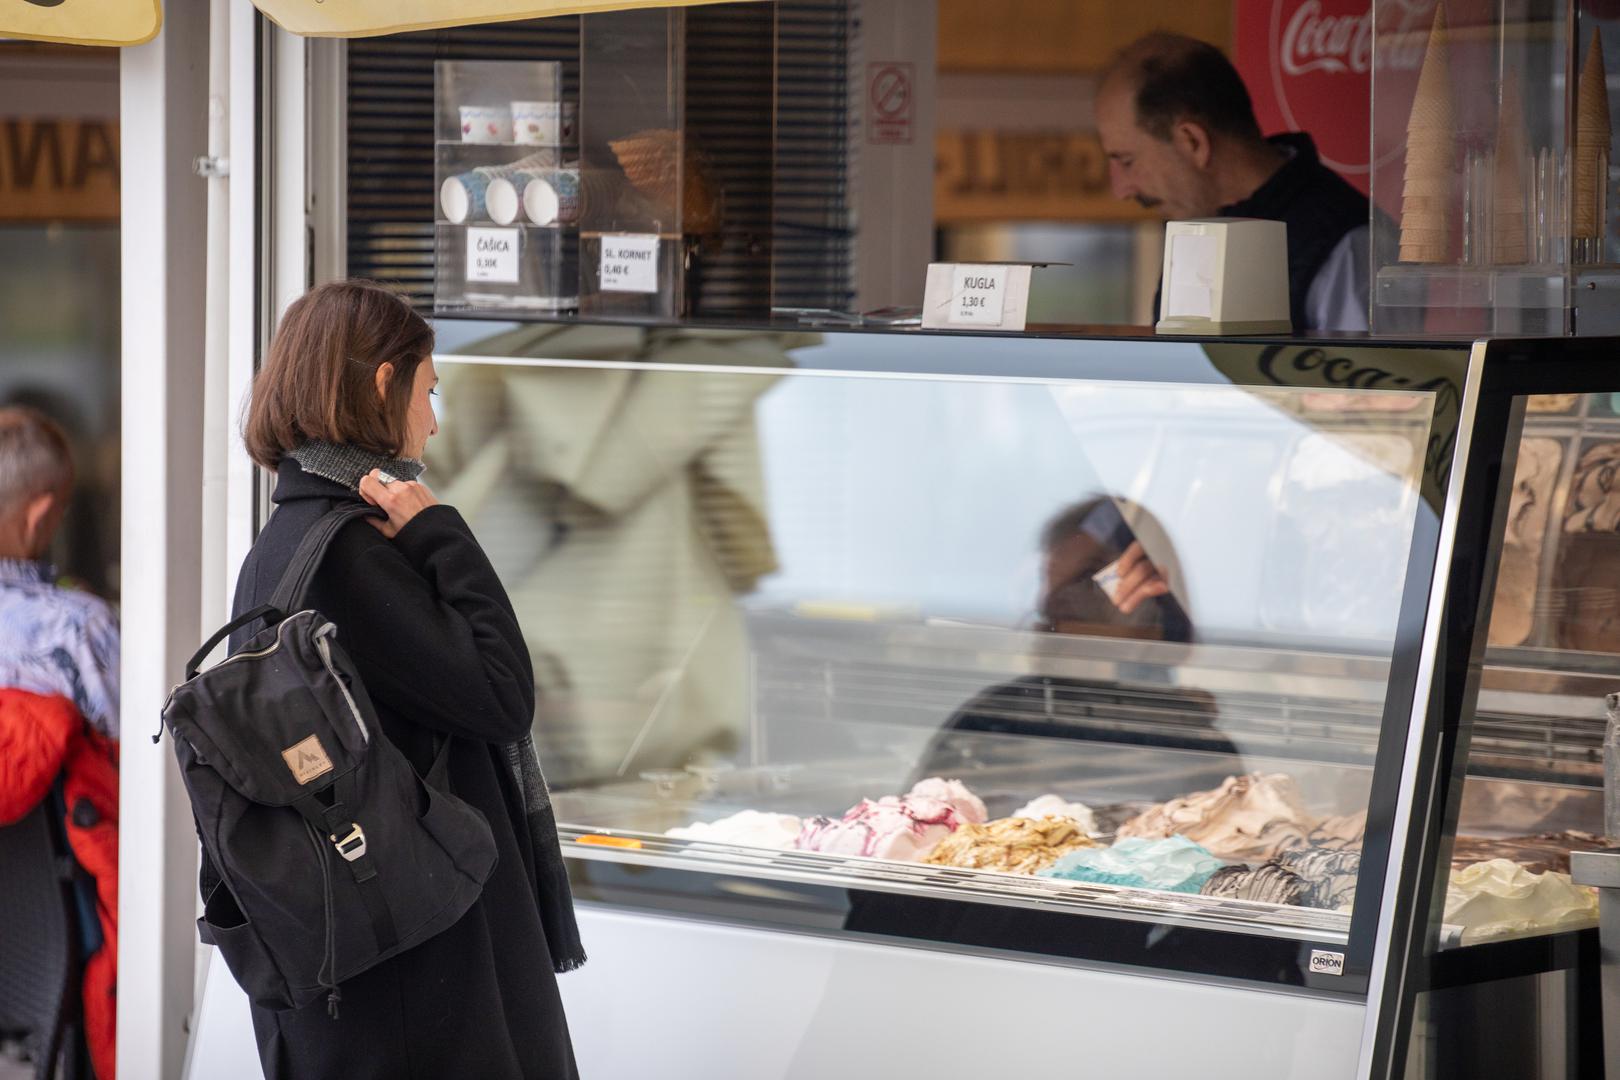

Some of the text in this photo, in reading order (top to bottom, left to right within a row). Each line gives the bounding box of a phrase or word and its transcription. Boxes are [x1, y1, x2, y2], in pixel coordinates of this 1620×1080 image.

[477, 236, 509, 252] ČAŠICA
[618, 249, 651, 260] KORNET
[964, 277, 995, 289] KUGLA
[962, 296, 986, 307] 1,30 €
[1312, 957, 1342, 967] ORION
